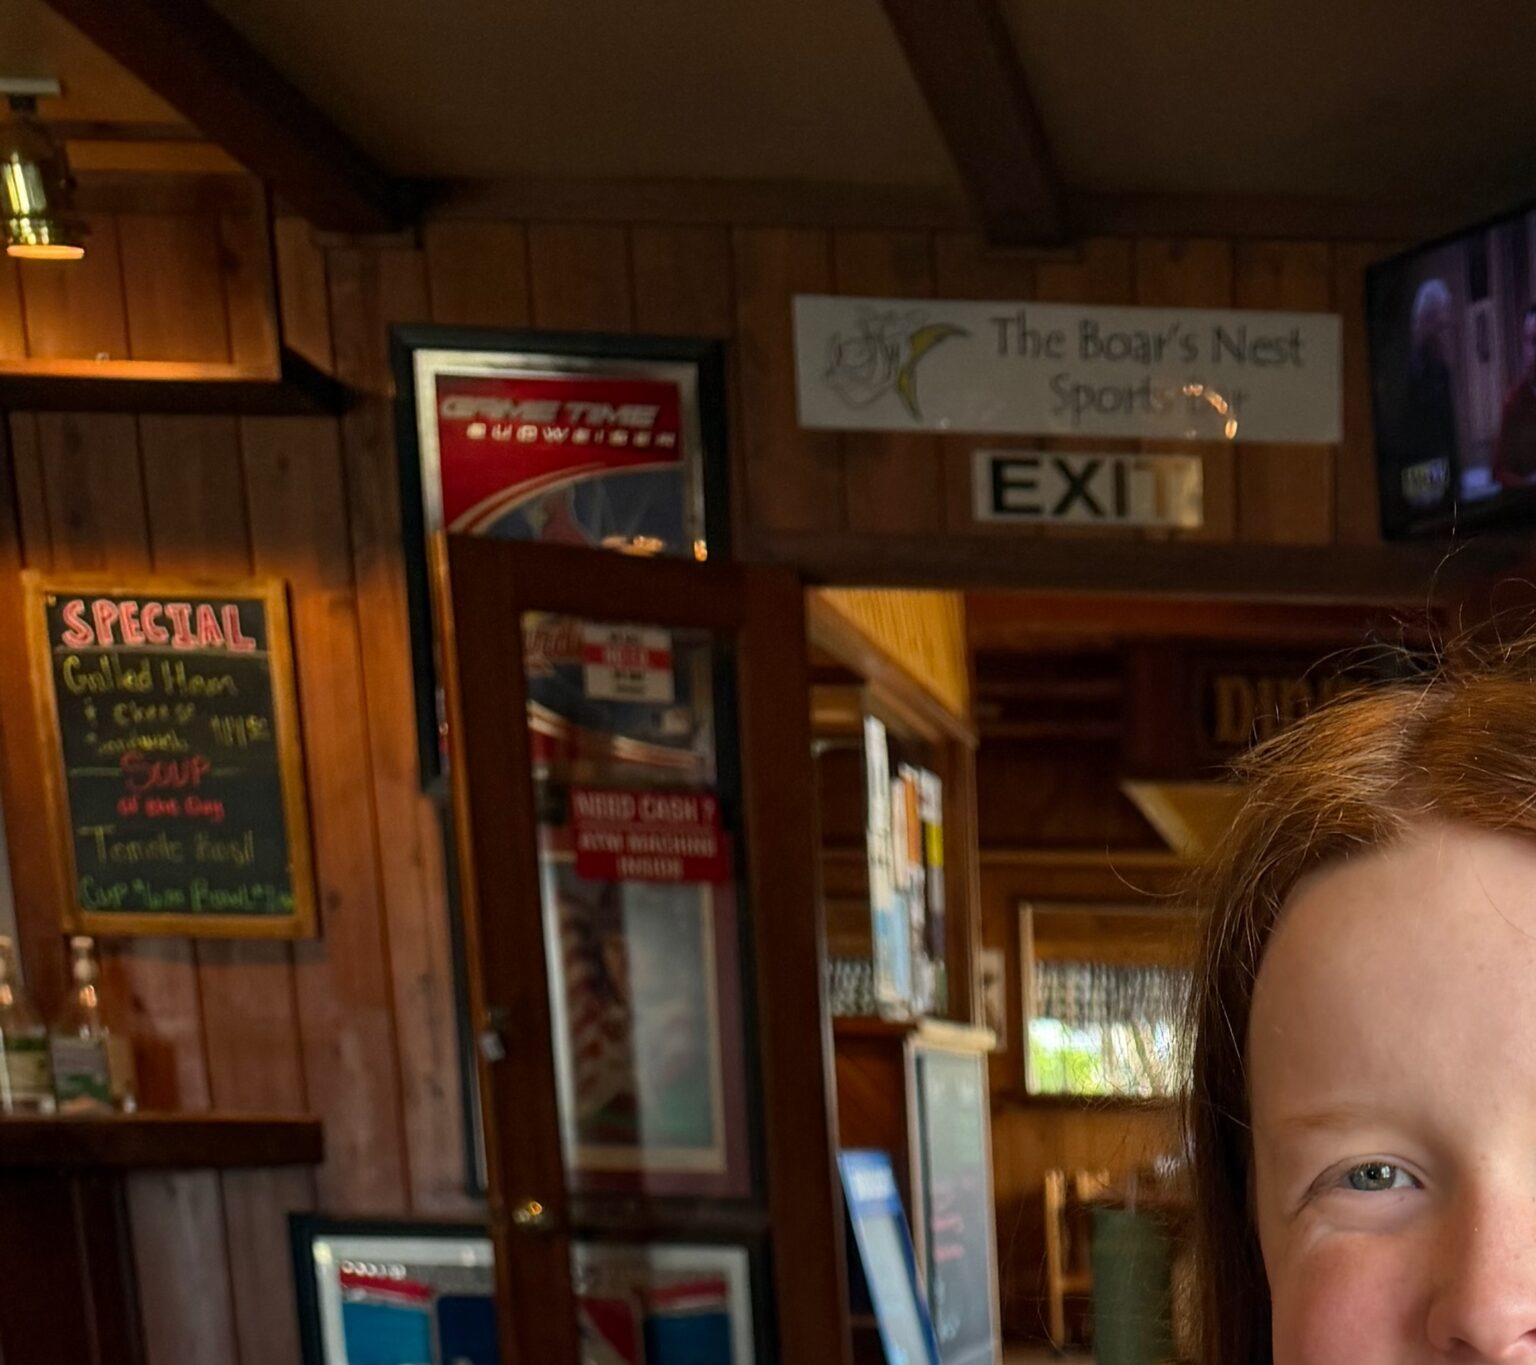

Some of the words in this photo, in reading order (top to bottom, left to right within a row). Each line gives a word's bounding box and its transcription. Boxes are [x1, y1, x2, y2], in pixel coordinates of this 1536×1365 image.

[991, 309, 1065, 359] The
[1079, 319, 1200, 366] Boar's
[1212, 325, 1305, 368] Nest
[442, 399, 558, 422] GAME
[566, 402, 660, 429] TIME
[1051, 373, 1171, 425] Sports
[466, 422, 676, 449] BUDWEISER
[991, 456, 1187, 519] EXIT
[61, 599, 256, 651] SPECIAL
[161, 659, 237, 695] Ham
[575, 791, 635, 817] NEED
[641, 793, 698, 822] CASH
